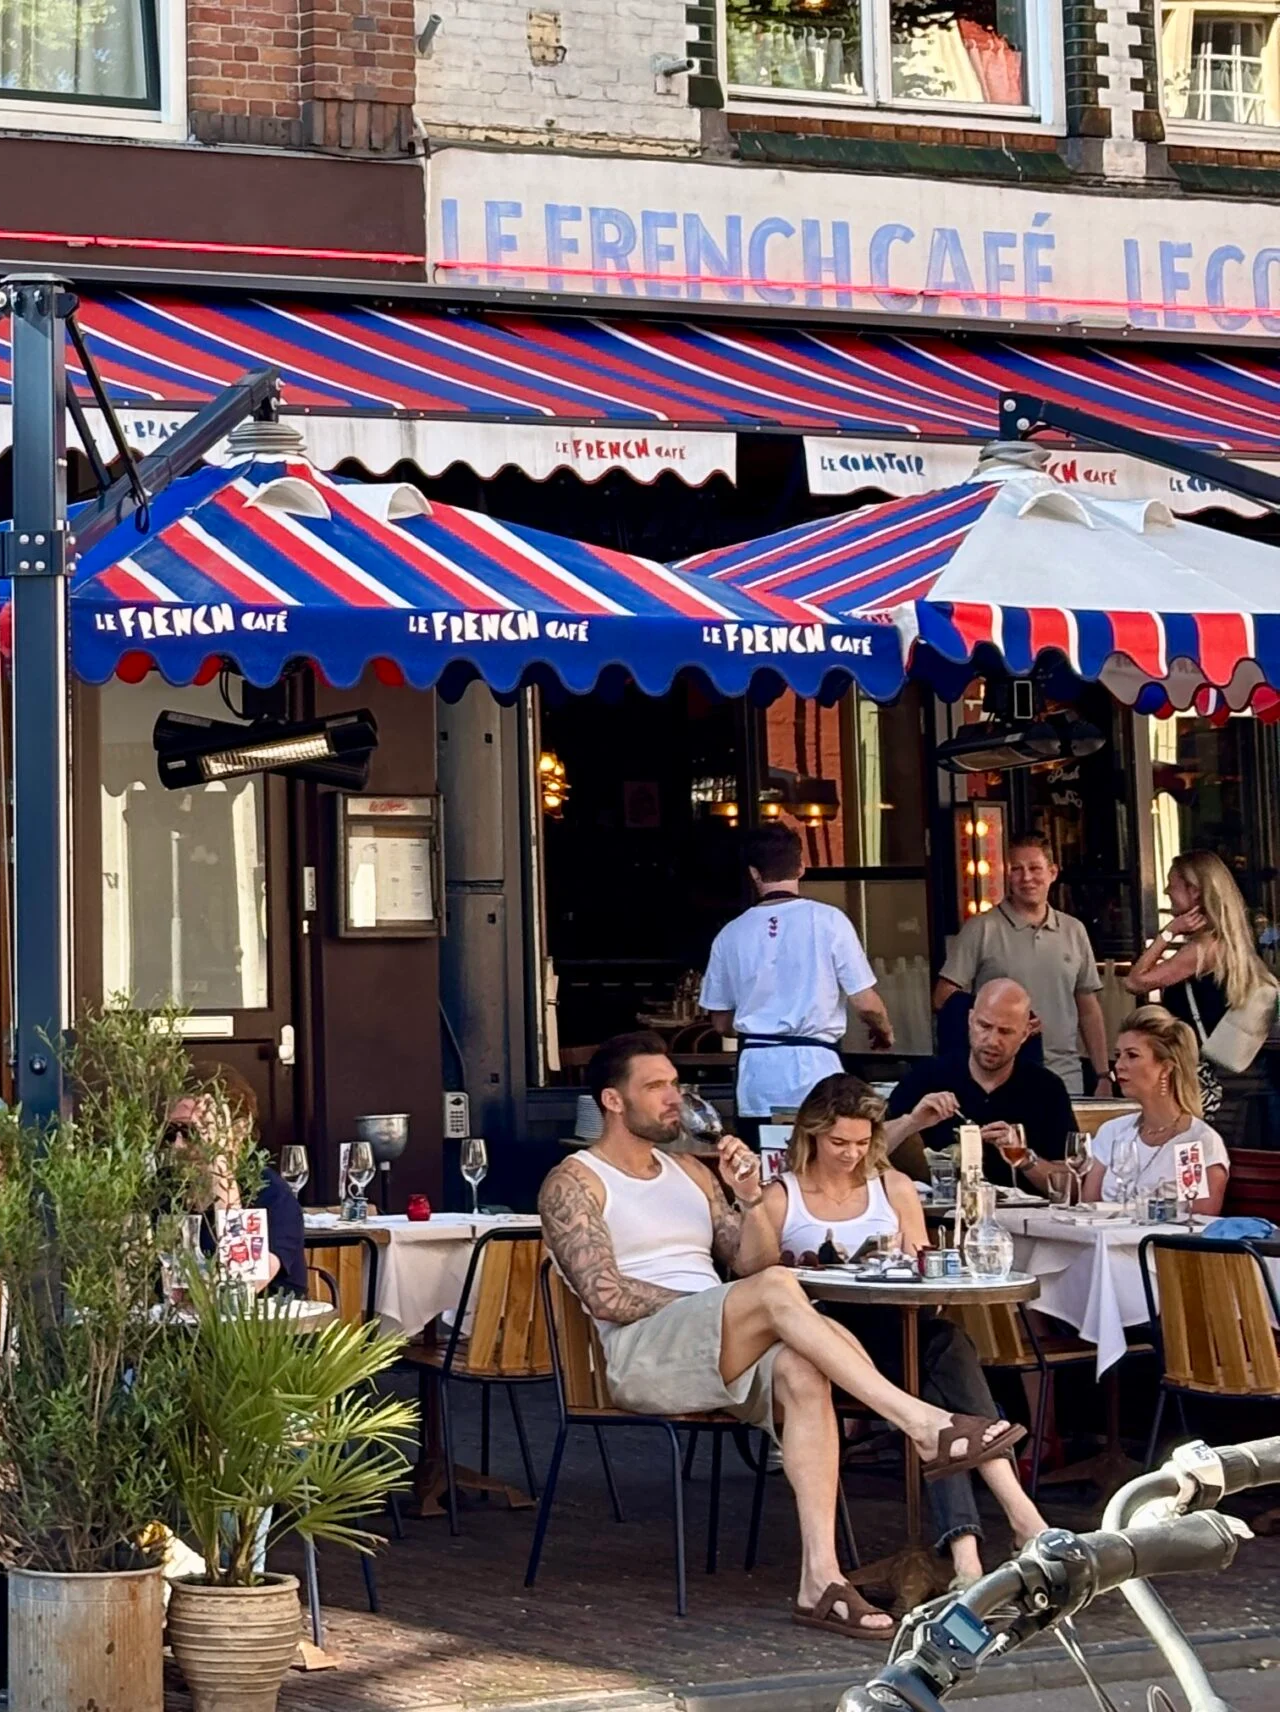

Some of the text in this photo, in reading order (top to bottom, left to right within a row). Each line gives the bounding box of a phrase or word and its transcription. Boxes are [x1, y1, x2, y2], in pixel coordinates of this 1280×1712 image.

[440, 198, 1059, 322] LE FRENCH CAFÉ
[1123, 238, 1197, 329] LE
[572, 438, 650, 460] FRENCH
[821, 451, 926, 477] LE COMPTOIR
[95, 602, 289, 640] LE FRENCH CAFÉ
[408, 610, 589, 643] LE FRENCH CAFÉ
[702, 623, 873, 656] LE FRENCH CAFÉ
